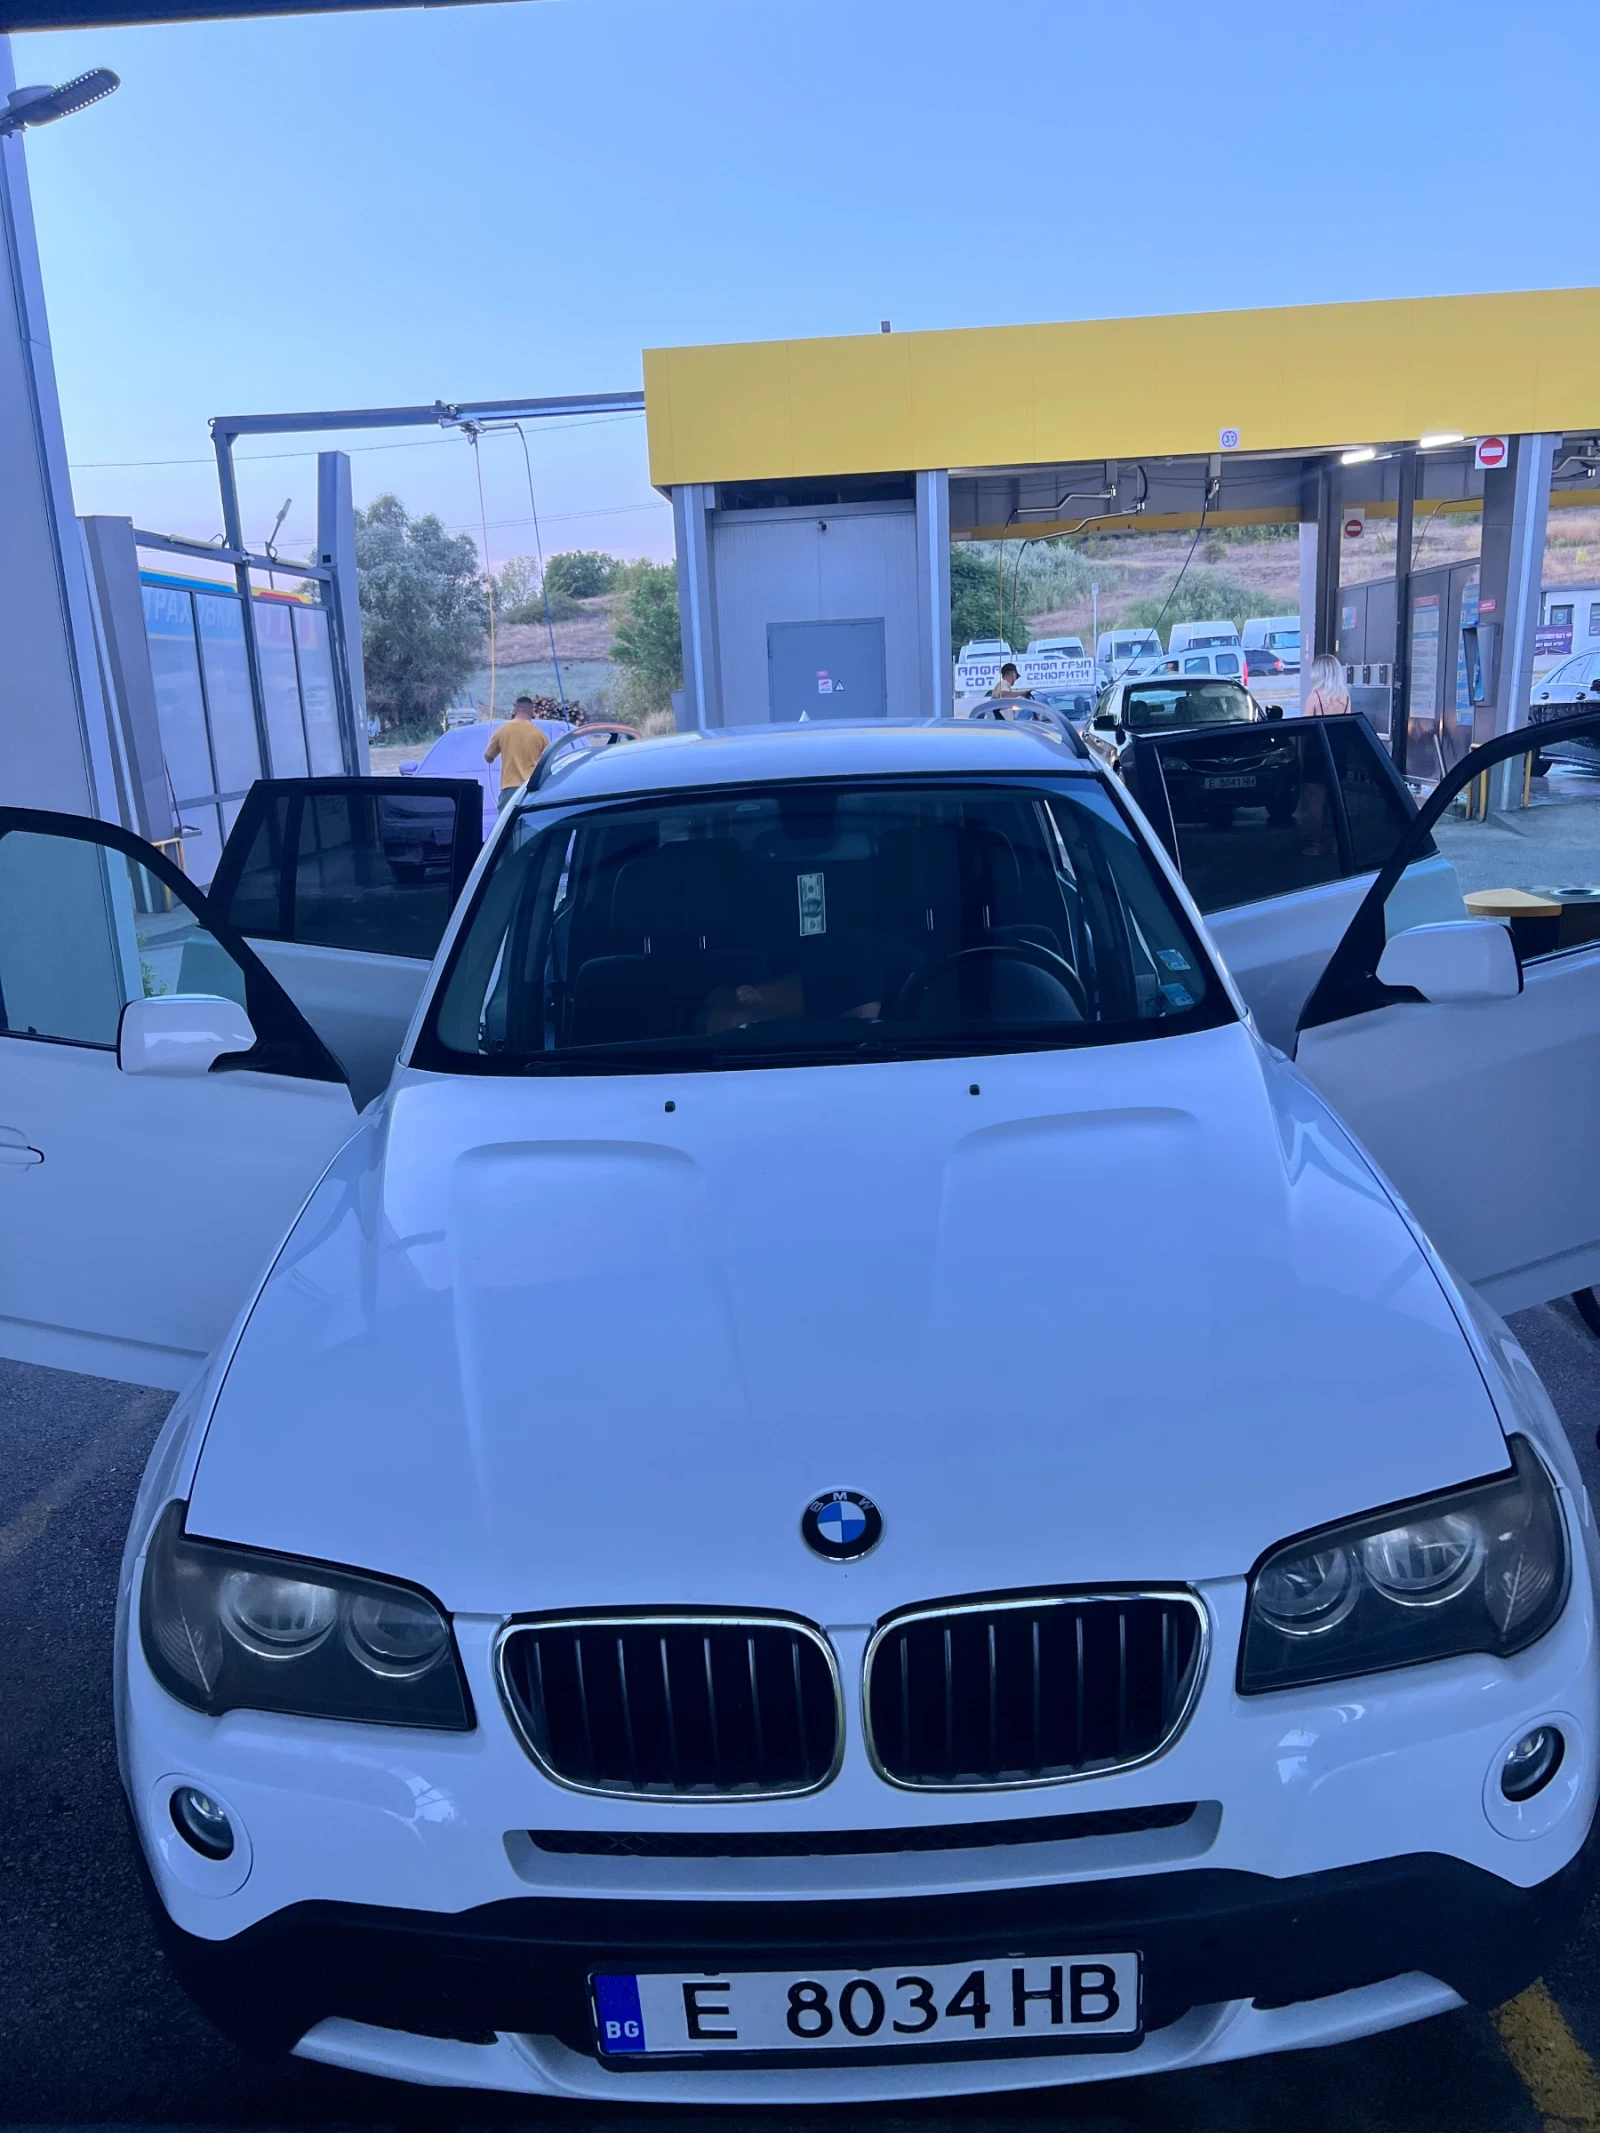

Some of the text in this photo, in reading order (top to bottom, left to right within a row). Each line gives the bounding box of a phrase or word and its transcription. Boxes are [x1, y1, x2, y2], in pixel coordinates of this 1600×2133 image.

[1061, 660, 1091, 670] ГРУП
[965, 677, 995, 687] СОТ
[1026, 670, 1089, 680] СЕКЮРИТИ
[809, 1491, 875, 1513] BMW
[682, 1963, 1121, 2040] E 8034 HB
[605, 2019, 640, 2039] BG
